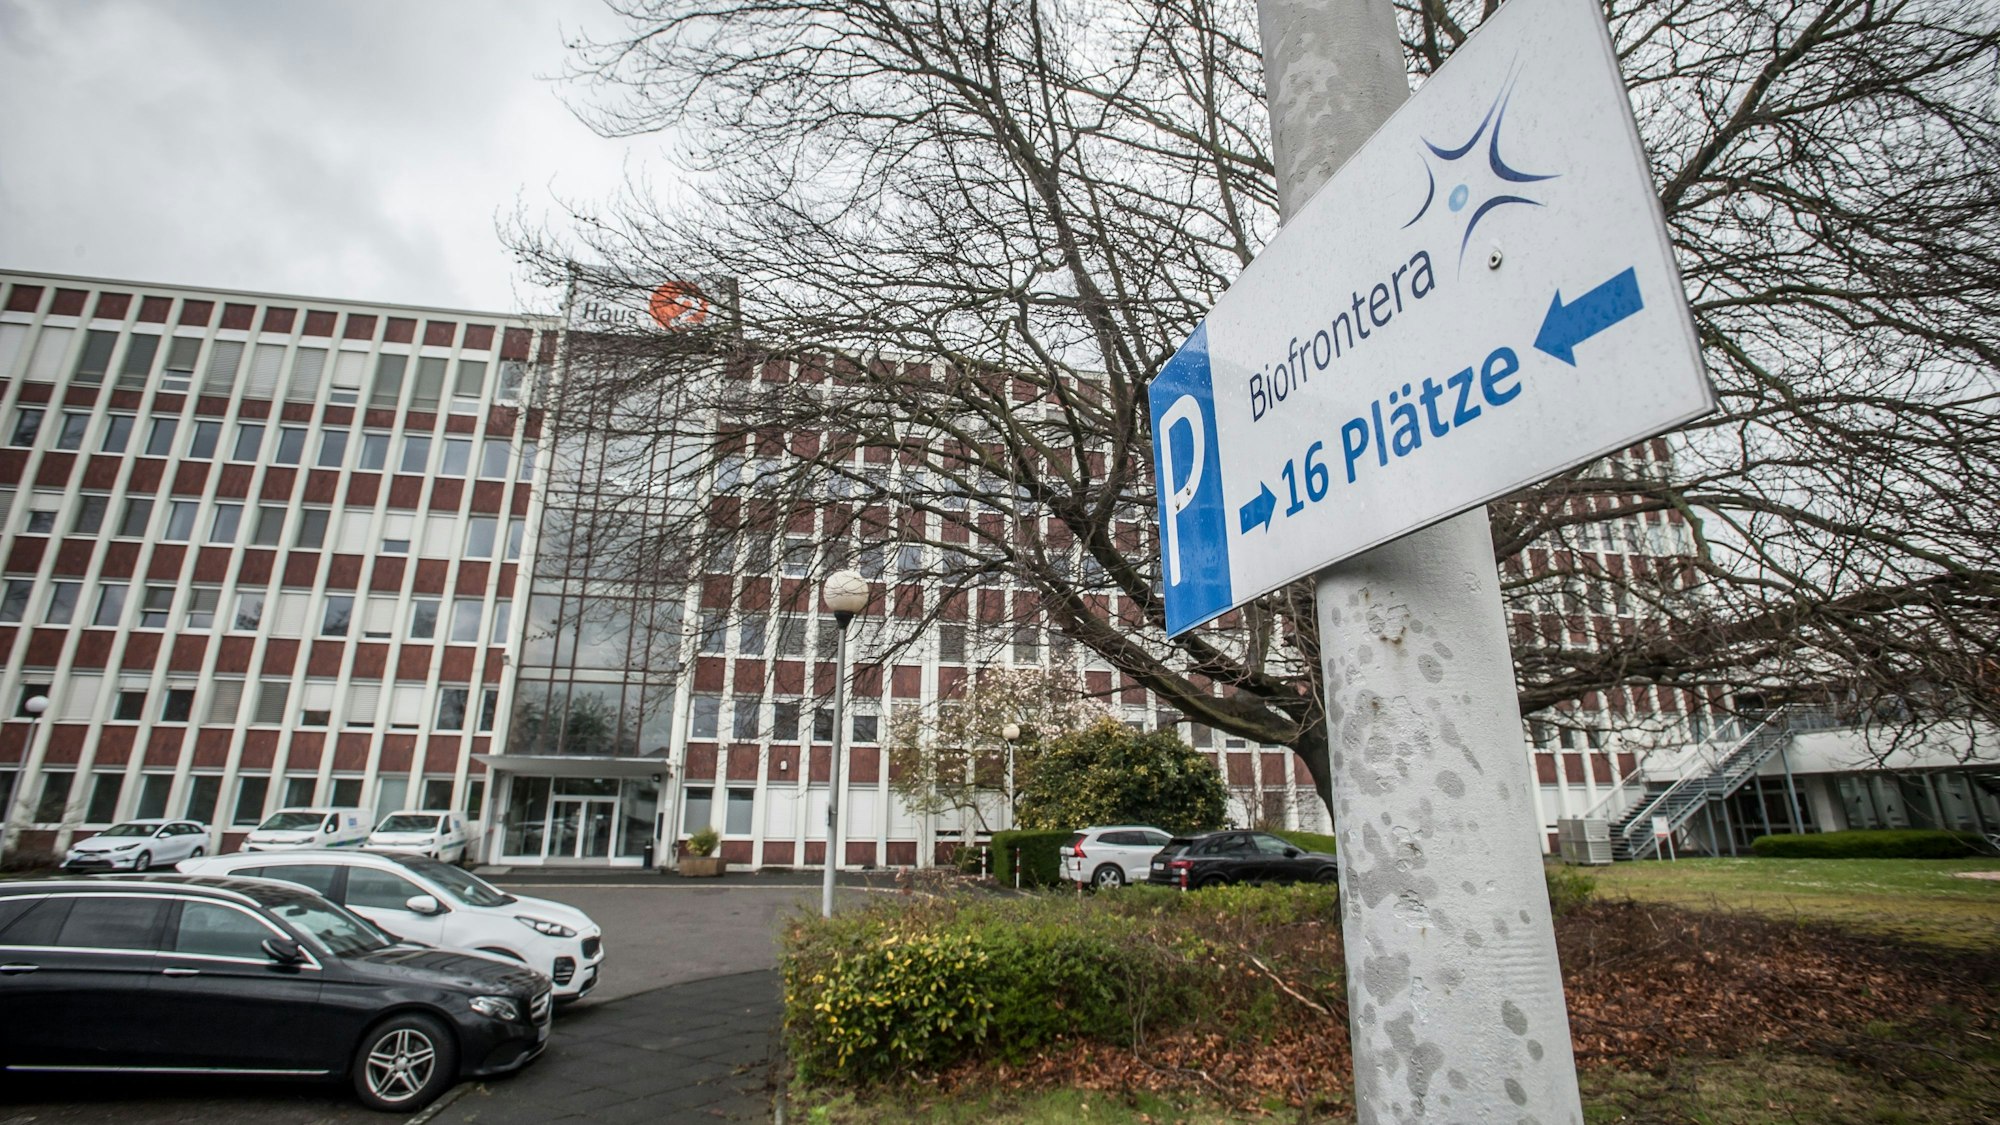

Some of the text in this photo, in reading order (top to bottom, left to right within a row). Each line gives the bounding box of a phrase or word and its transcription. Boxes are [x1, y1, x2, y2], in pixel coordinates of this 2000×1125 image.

[583, 302, 638, 323] Haus
[1249, 250, 1435, 422] Biofrontera
[1159, 394, 1205, 587] P
[1281, 346, 1522, 518] 16 Plätze
